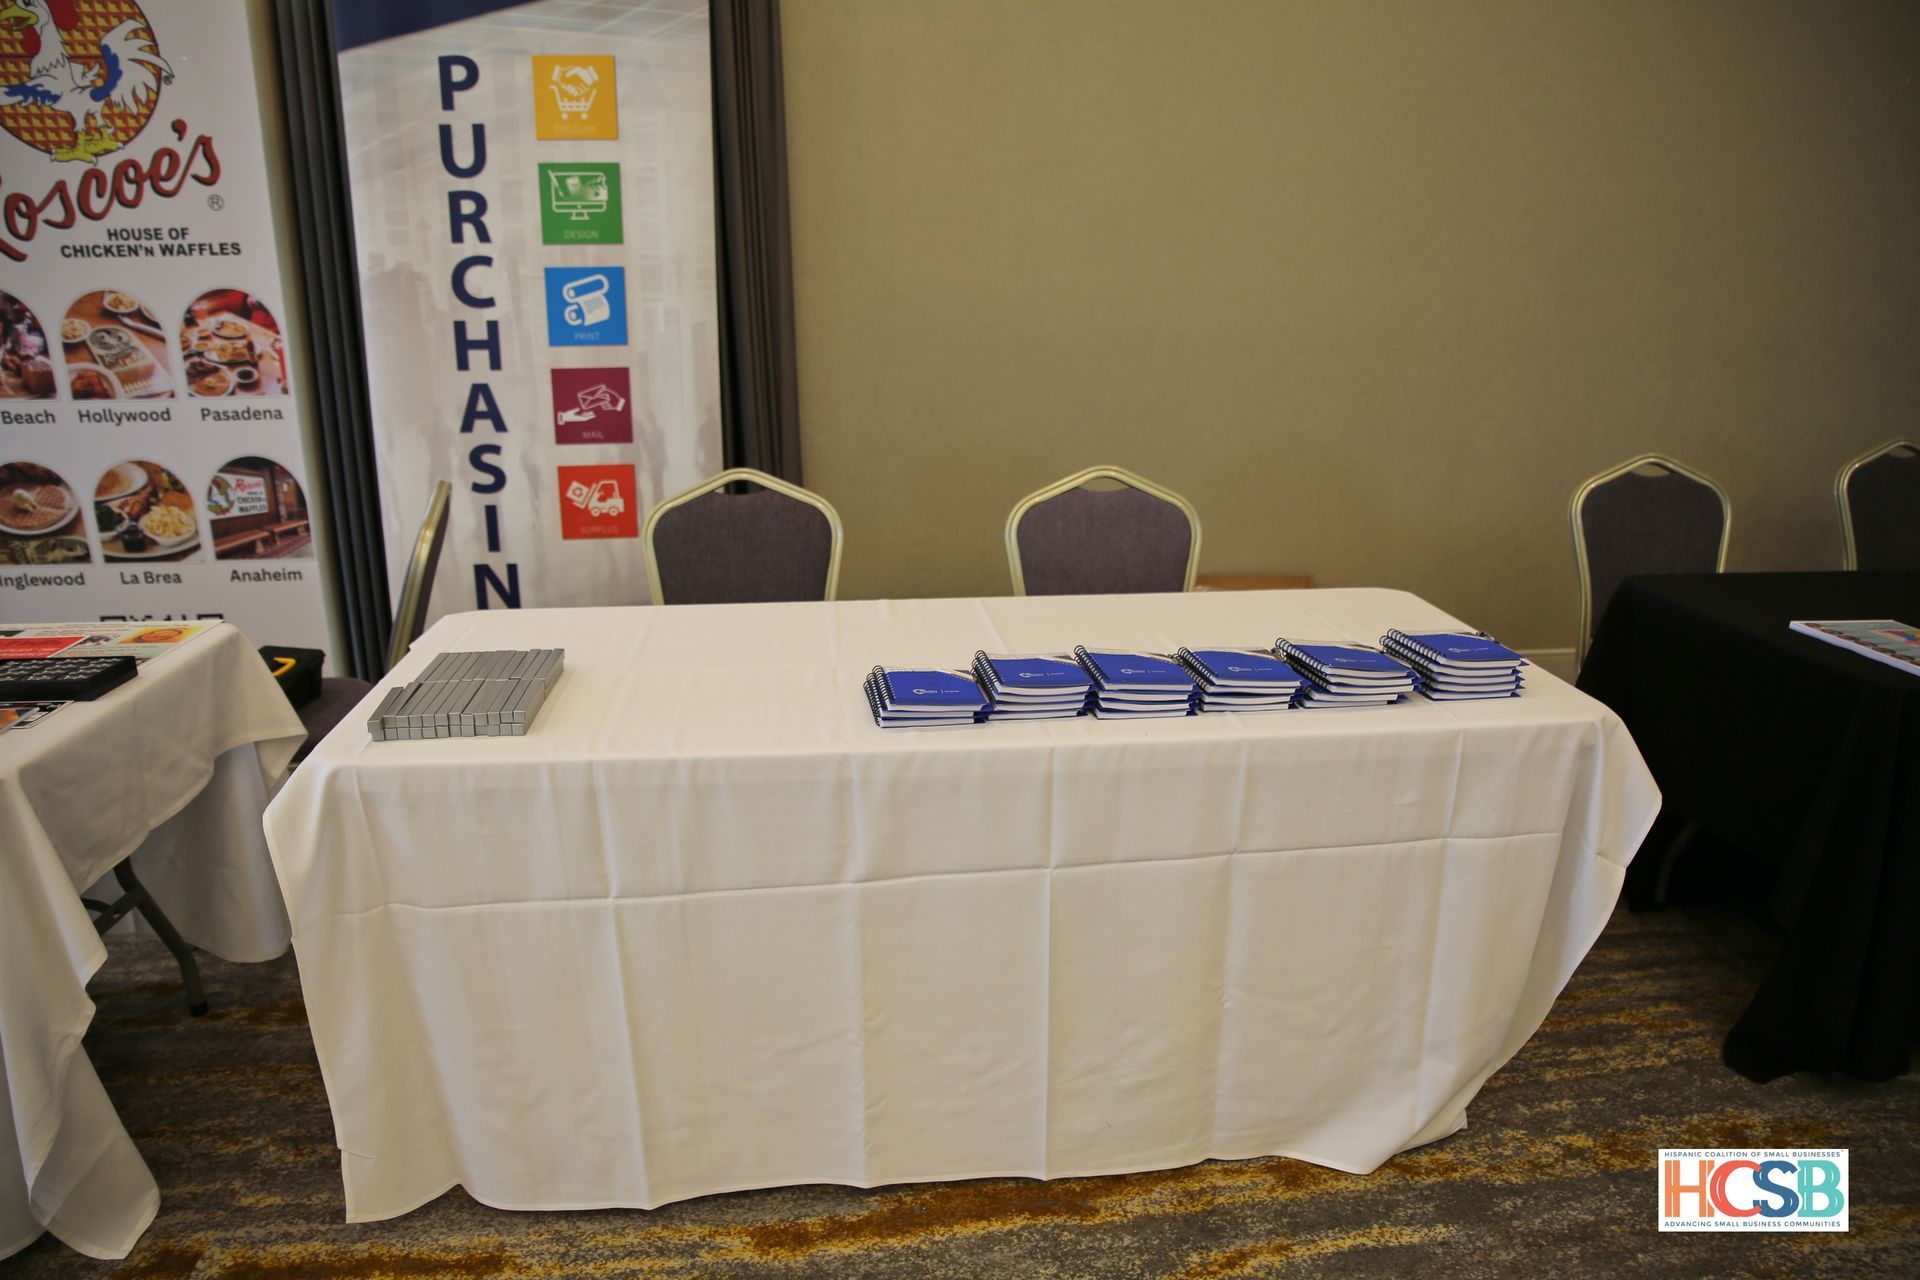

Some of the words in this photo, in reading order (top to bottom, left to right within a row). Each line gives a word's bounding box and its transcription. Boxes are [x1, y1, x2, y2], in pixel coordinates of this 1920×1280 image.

[0, 118, 221, 262] oscoe's
[107, 228, 163, 241] HOUSE
[168, 227, 189, 240] OF
[564, 230, 599, 240] DESIGN
[158, 242, 241, 256] WAFFLES
[574, 332, 600, 341] PRINT
[1, 409, 56, 424] Beach
[78, 407, 172, 426] Hollywood
[200, 407, 284, 421] Pasadena
[0, 572, 85, 591] Inglewood
[120, 571, 140, 585] La
[143, 571, 183, 585] Brea
[230, 567, 303, 583] Anaheim
